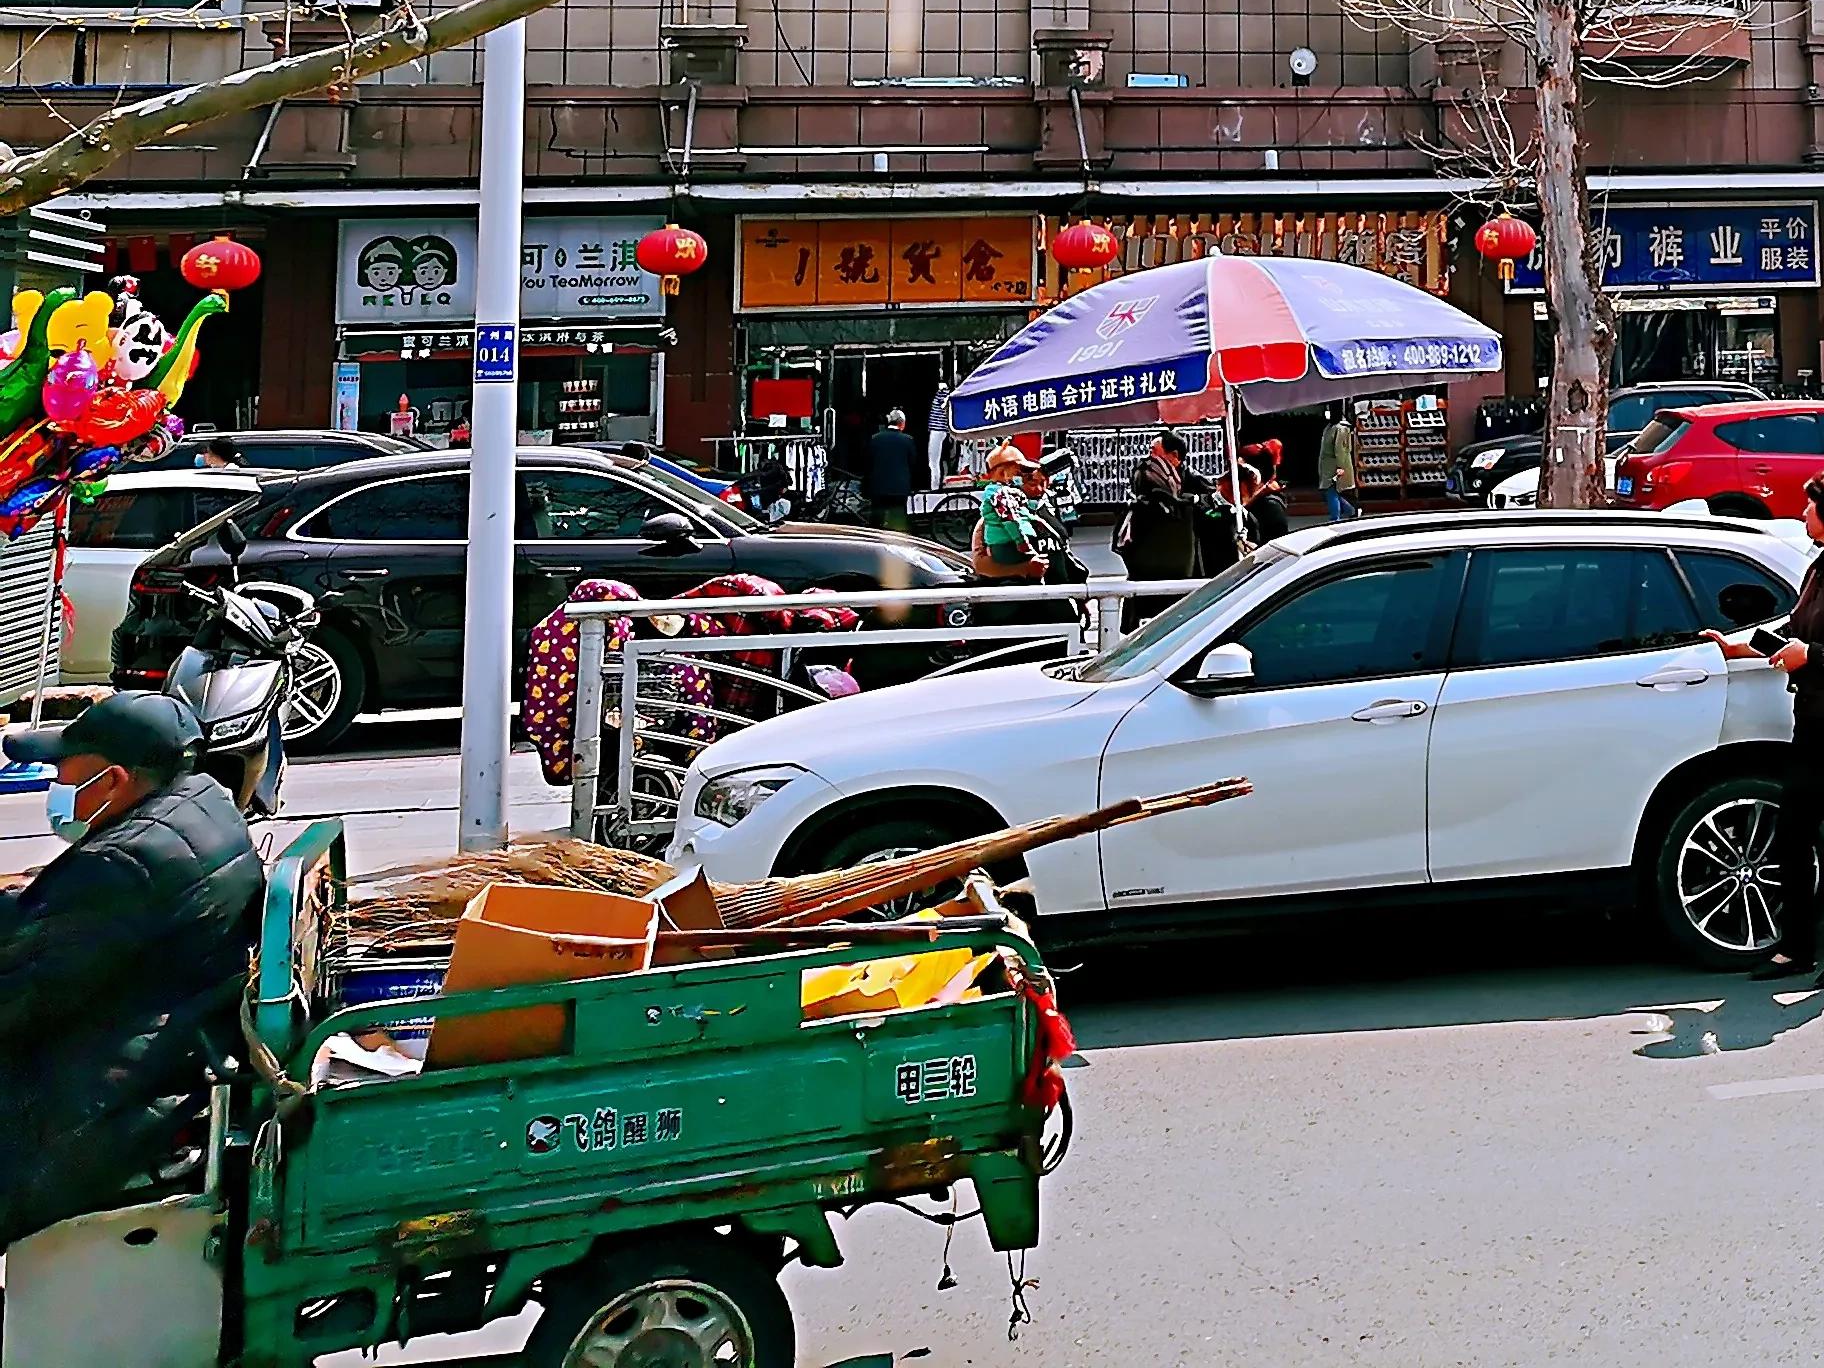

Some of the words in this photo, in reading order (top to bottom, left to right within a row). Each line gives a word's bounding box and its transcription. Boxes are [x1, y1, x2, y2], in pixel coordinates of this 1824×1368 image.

[1759, 215, 1808, 241] 平价
[1760, 246, 1810, 270] 服装
[479, 346, 510, 363] 014
[1067, 339, 1125, 365] 1991
[984, 394, 1019, 421] 外语
[1022, 388, 1058, 413] 电脑
[1061, 380, 1097, 405] 会计
[1100, 374, 1136, 400] 证书
[1139, 369, 1178, 393] 礼仪
[895, 1054, 977, 1105] 电三轮
[563, 1107, 682, 1154] 飞鸽醒狮
